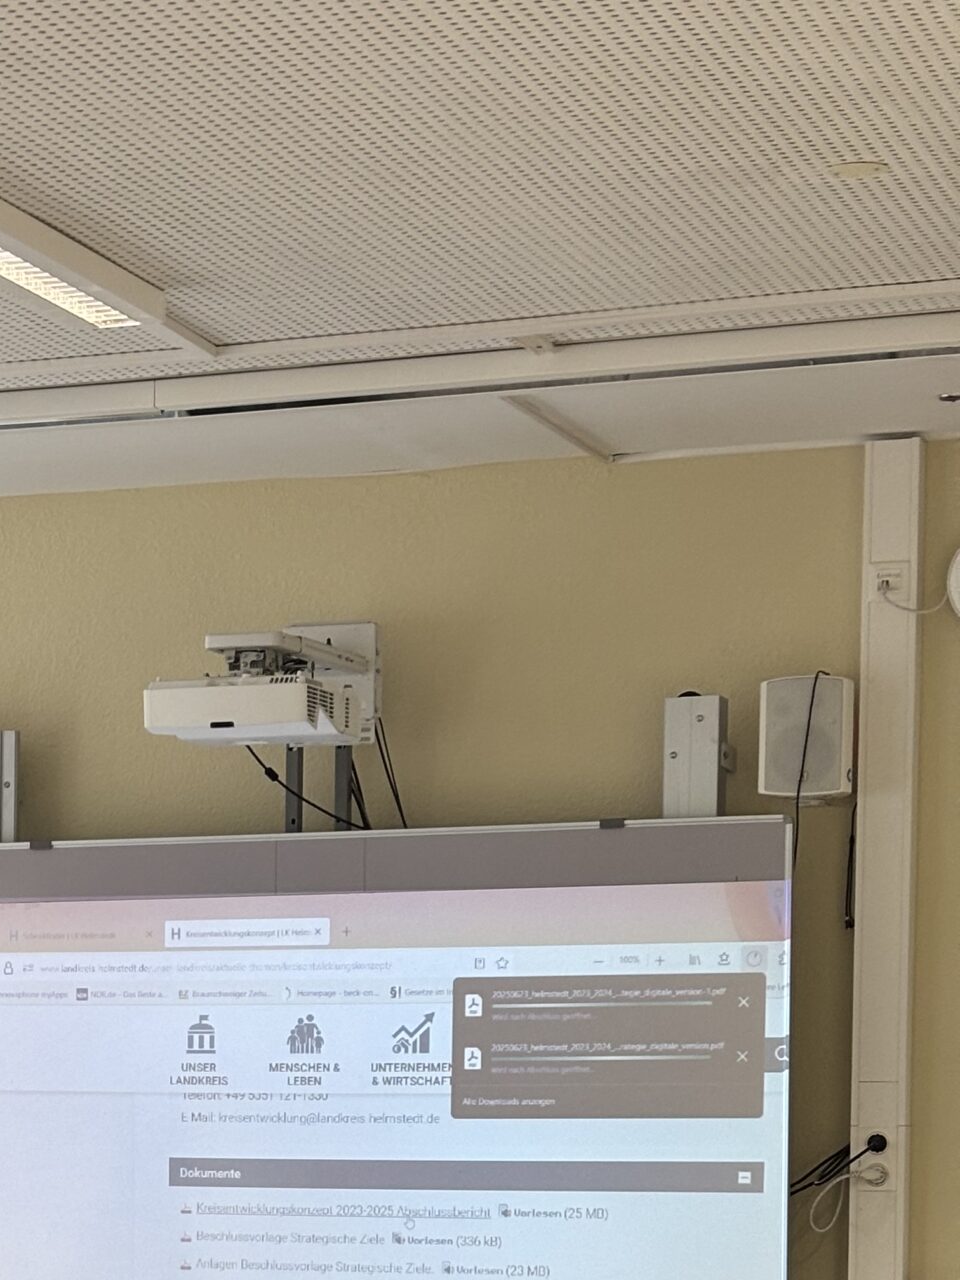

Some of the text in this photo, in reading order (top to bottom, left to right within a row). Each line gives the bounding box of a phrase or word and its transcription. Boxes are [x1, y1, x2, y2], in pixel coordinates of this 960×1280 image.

[181, 1062, 216, 1073] UNSER
[269, 1063, 340, 1073] MENSCHEN &
[169, 1076, 228, 1086] LANDKREIS
[287, 1076, 322, 1086] LEBEN
[372, 1076, 379, 1086] &
[218, 1111, 440, 1126] kreisentwicklung@landkreishelmstedt.de
[179, 1168, 241, 1180] Dokumente
[196, 1202, 608, 1221] Kreisentwicklungskonzept 2023-2025 Abschlussbericht Vorlesen (25 MB)
[196, 1231, 502, 1249] Beschlussvorlage Strategische Ziele Vorlesen (336 kB)
[196, 1259, 238, 1272] Anlagen
[241, 1260, 333, 1273] Beschlussvorlage
[336, 1261, 402, 1274] Strategische
[457, 1266, 503, 1276] Vorlesen
[506, 1265, 524, 1278] (23
[527, 1265, 550, 1278] MB)
